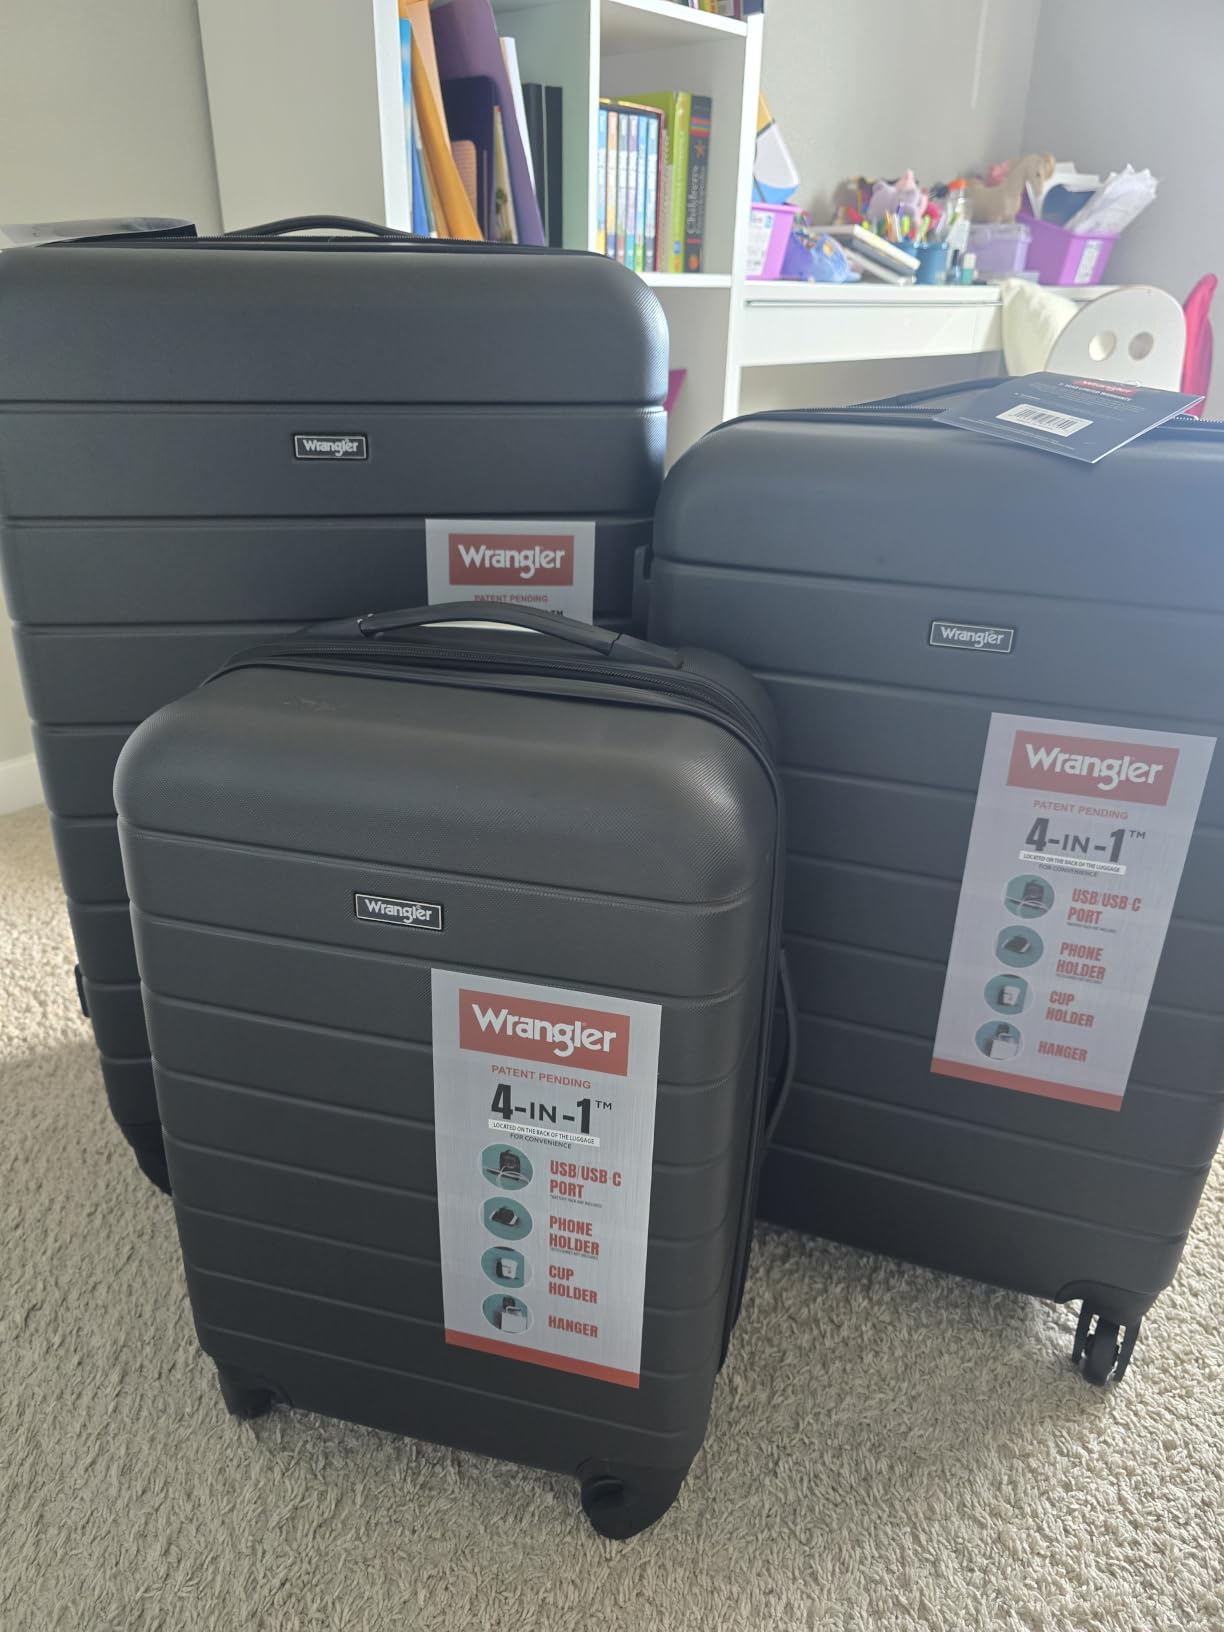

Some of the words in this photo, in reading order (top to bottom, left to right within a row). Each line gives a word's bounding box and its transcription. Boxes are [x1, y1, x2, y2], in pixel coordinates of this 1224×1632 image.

[303, 439, 358, 456] Wrangler
[457, 544, 565, 579] Wrangler
[474, 594, 507, 603] PATENT
[510, 595, 548, 603] PENDING
[941, 627, 1004, 648] Wrangler
[1025, 744, 1163, 791] Wrangler
[1032, 800, 1076, 814] PATENT
[1078, 805, 1129, 820] PENDING
[1023, 853, 1046, 862] LOCATED
[1096, 863, 1121, 873] LUGGAGE
[364, 899, 432, 924] Wrangler
[1067, 907, 1102, 925] PORT
[1060, 942, 1103, 961] PHONE
[1056, 959, 1106, 980] HOLDER
[1049, 991, 1075, 1006] CUP
[1045, 1007, 1094, 1027] HOLDER
[472, 1004, 616, 1057] Wrangler
[1038, 1040, 1088, 1062] HANGER
[491, 1064, 536, 1080] PATENT
[539, 1071, 591, 1089] PENDING
[493, 1122, 516, 1131] LOCATED
[526, 1127, 536, 1135] THE
[536, 1129, 550, 1137] BACK
[569, 1135, 595, 1144] LUGGAGE
[524, 1135, 572, 1149] CONVENIENCE
[550, 1179, 584, 1198] PORT
[549, 1215, 593, 1236] PHONE
[549, 1233, 600, 1256] HOLDER
[548, 1265, 574, 1281] CUP
[548, 1282, 598, 1304] HOLDER
[548, 1315, 598, 1338] HANGER
